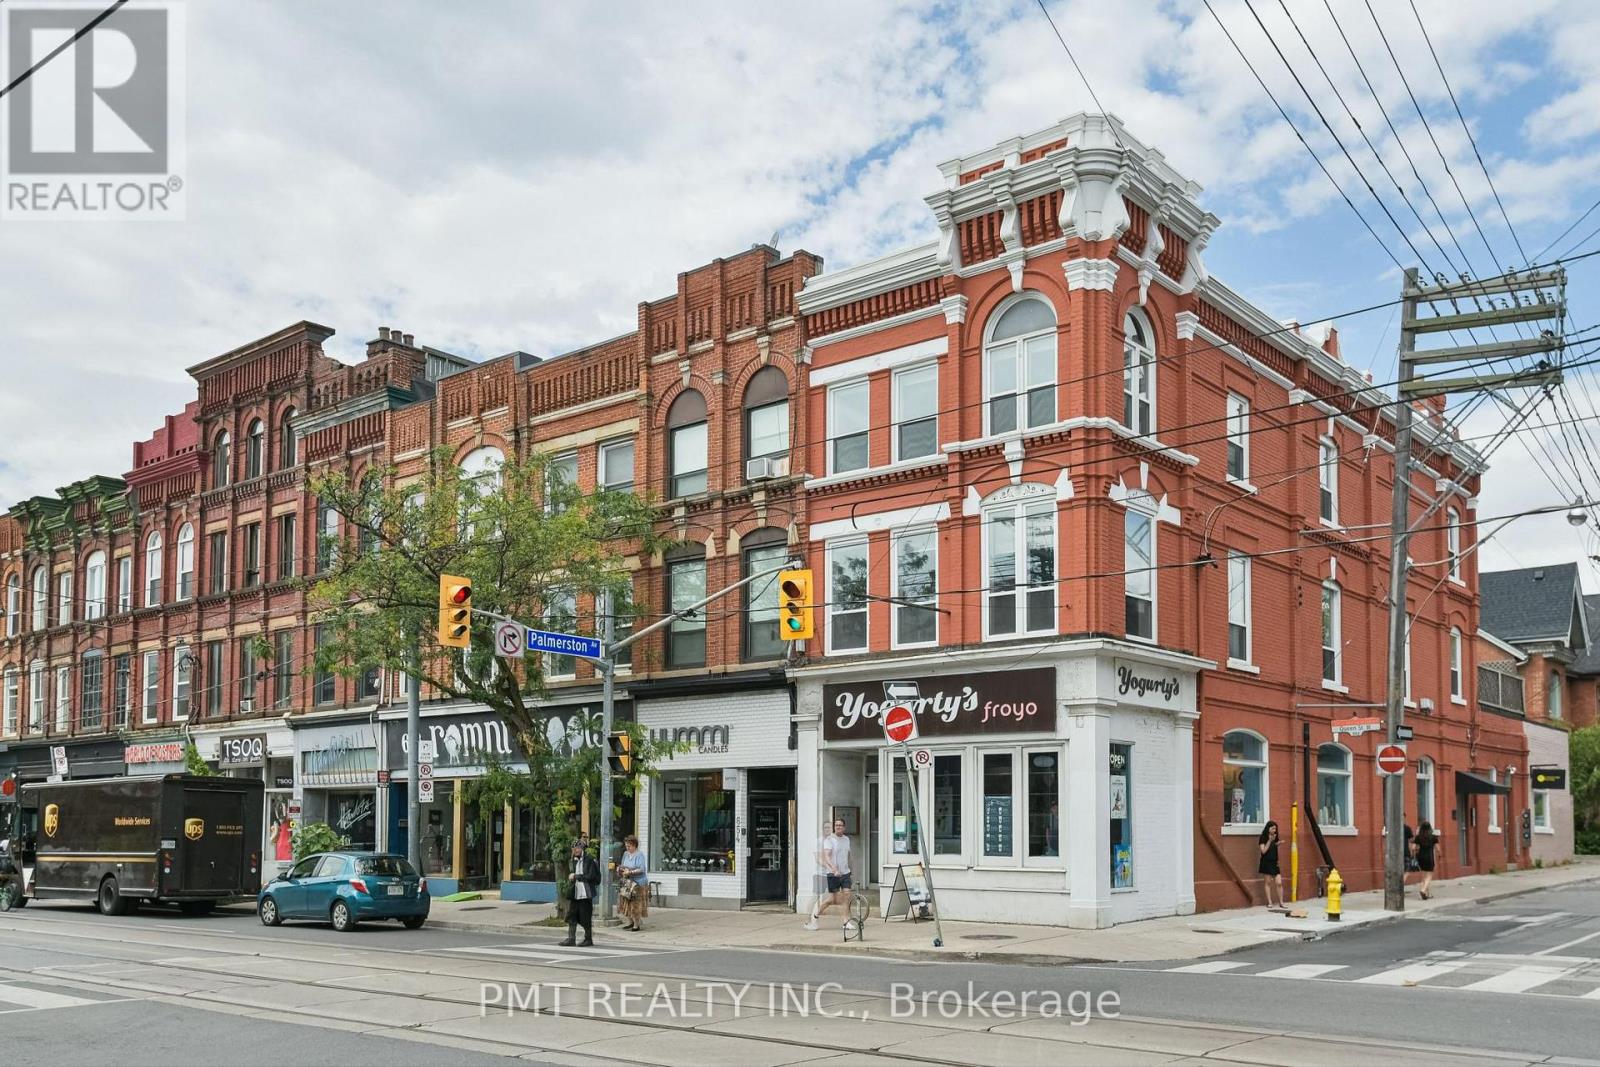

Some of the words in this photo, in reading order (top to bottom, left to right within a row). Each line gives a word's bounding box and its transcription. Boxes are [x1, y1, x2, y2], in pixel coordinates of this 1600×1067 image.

[530, 632, 588, 653] Palmerston
[1117, 666, 1180, 702] Yogurty's
[835, 686, 979, 729] Yorty's
[981, 701, 1038, 722] froyo
[532, 707, 604, 757] ools
[223, 738, 263, 757] TSOQ
[698, 745, 729, 754] CANDLES
[1110, 753, 1126, 765] OPEN
[46, 814, 58, 833] ups
[114, 817, 134, 826] Worldwide
[134, 816, 151, 826] Services
[186, 823, 202, 837] ups
